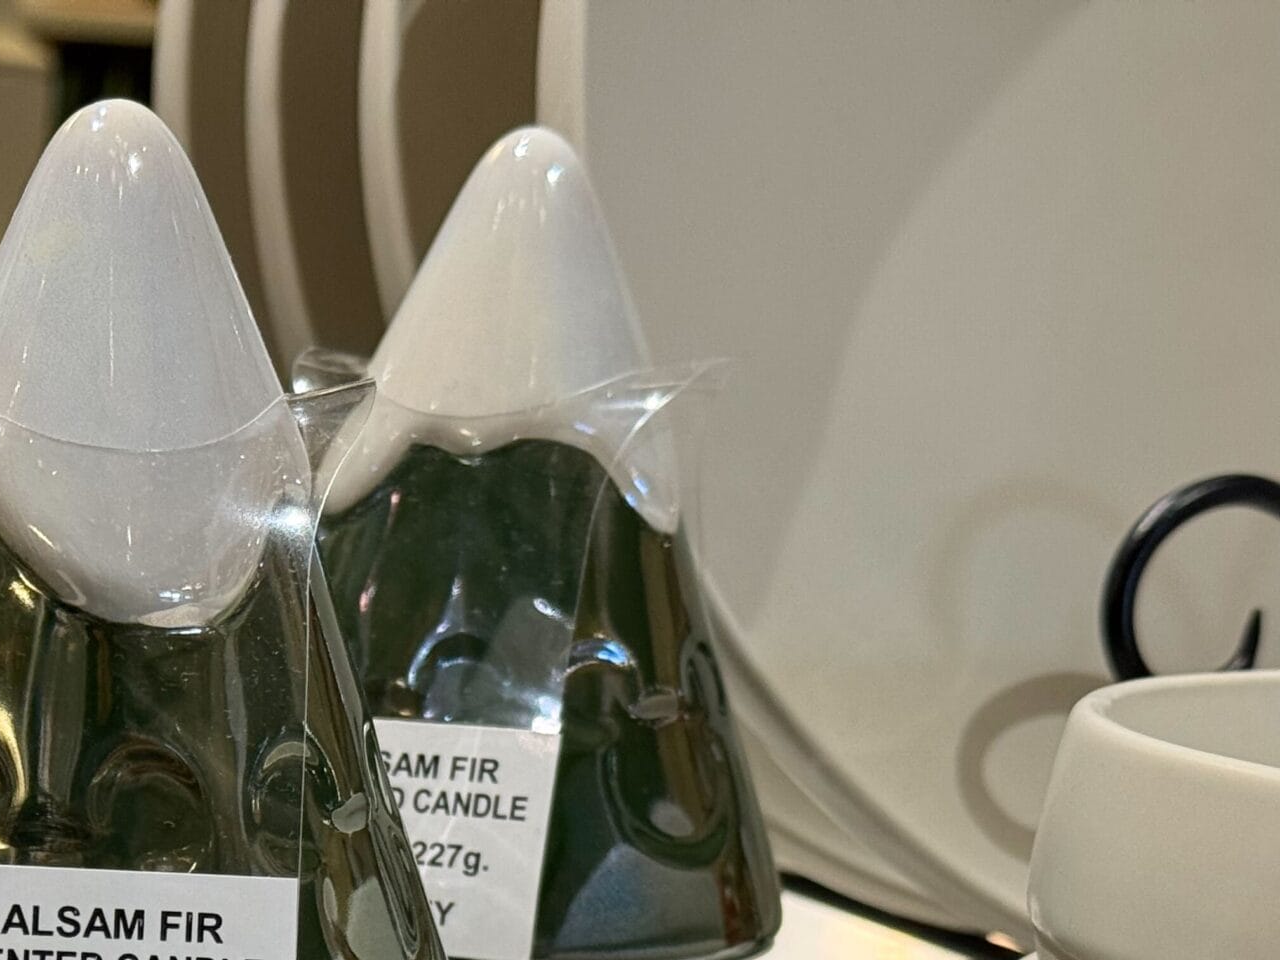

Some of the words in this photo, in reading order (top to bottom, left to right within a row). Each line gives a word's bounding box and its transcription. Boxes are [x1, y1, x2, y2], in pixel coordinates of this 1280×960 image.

[449, 756, 499, 784] FIR
[413, 789, 528, 821] CANDLE
[412, 841, 489, 876] 227g.
[160, 911, 224, 944] FIR
